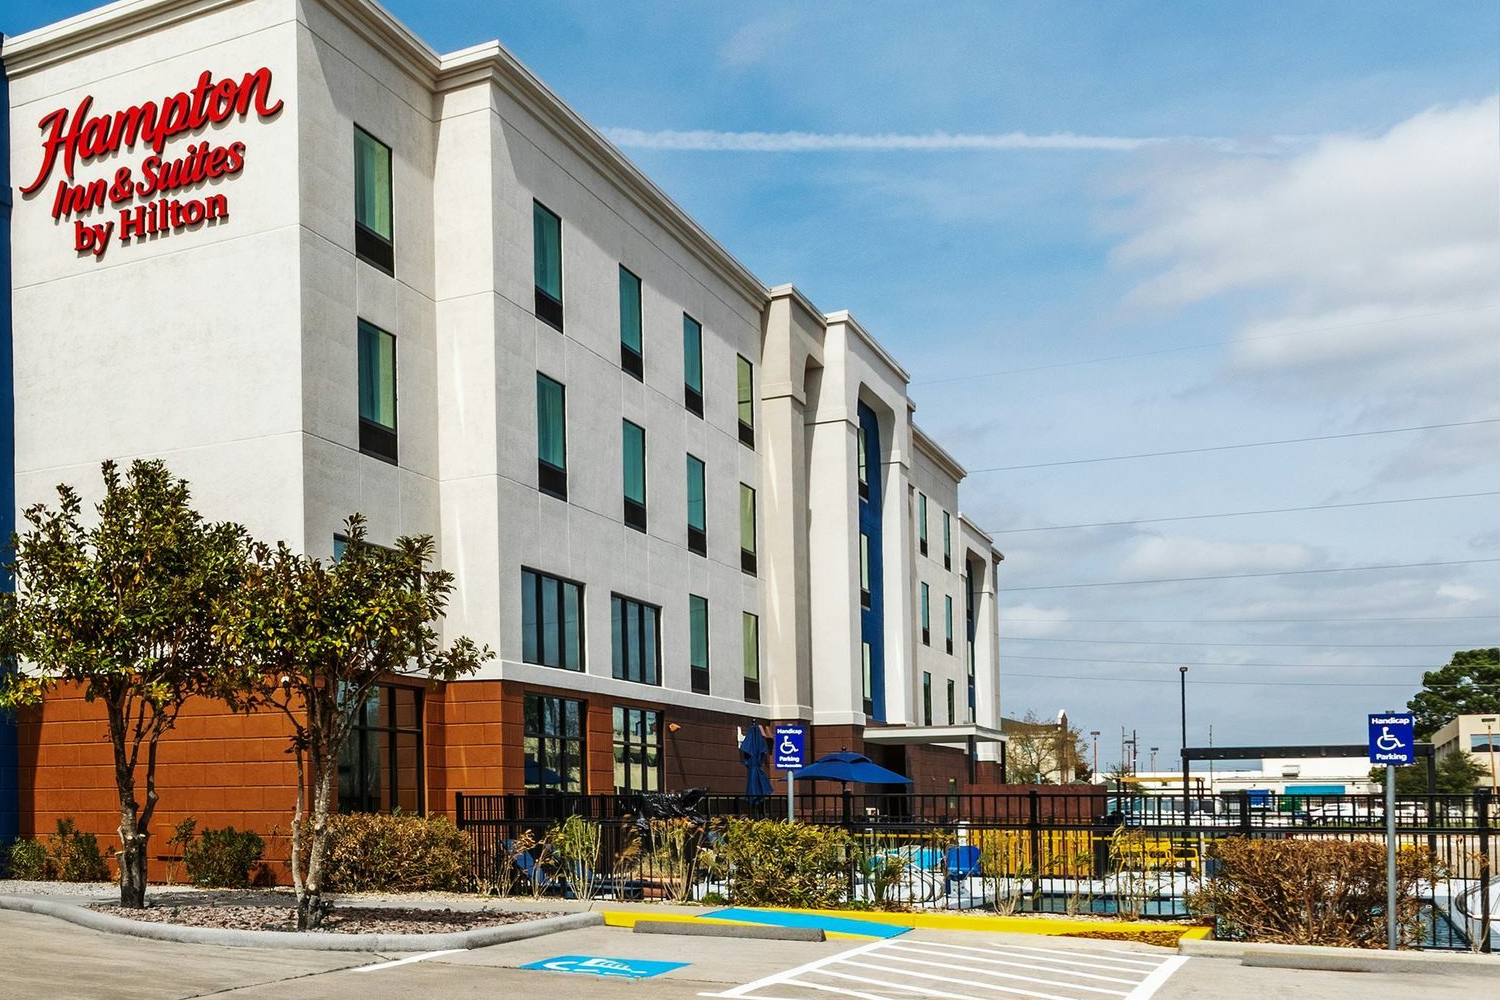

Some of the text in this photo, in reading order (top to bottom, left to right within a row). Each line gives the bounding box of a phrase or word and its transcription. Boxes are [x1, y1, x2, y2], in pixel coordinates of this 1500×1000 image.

[19, 66, 284, 194] Hampton
[52, 178, 107, 219] Inn
[135, 140, 246, 197] Suites
[73, 193, 229, 255] by Hilton
[1371, 717, 1410, 725] Handicap
[1376, 753, 1408, 762] Parking
